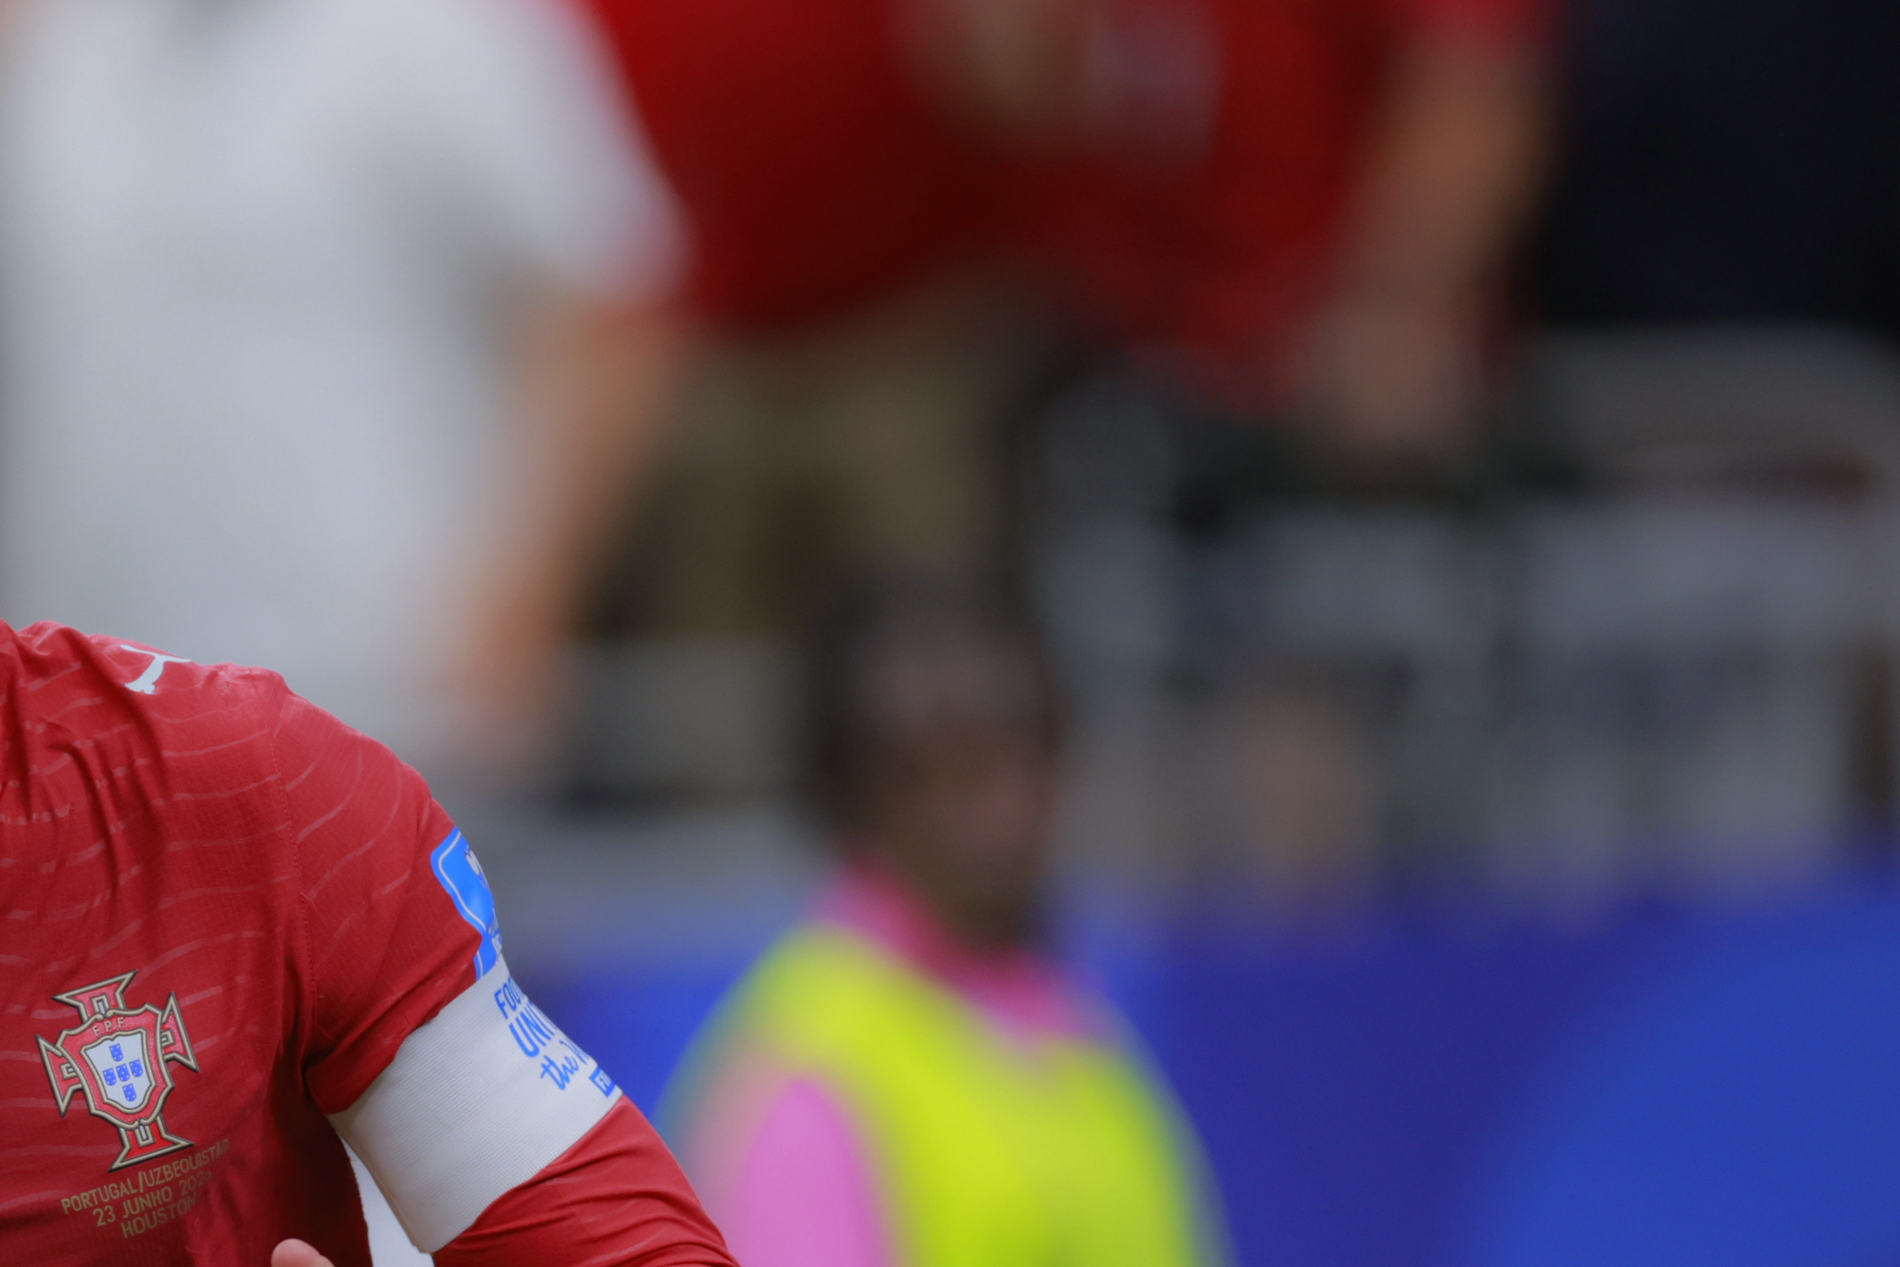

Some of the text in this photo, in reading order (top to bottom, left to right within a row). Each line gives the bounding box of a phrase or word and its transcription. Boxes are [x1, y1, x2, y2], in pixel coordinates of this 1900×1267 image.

[92, 1016, 128, 1037] F.P.F.
[540, 1055, 579, 1090] the
[92, 1205, 115, 1227] 23
[122, 1186, 173, 1219] JUNHO
[120, 1194, 198, 1239] HOUSTON
